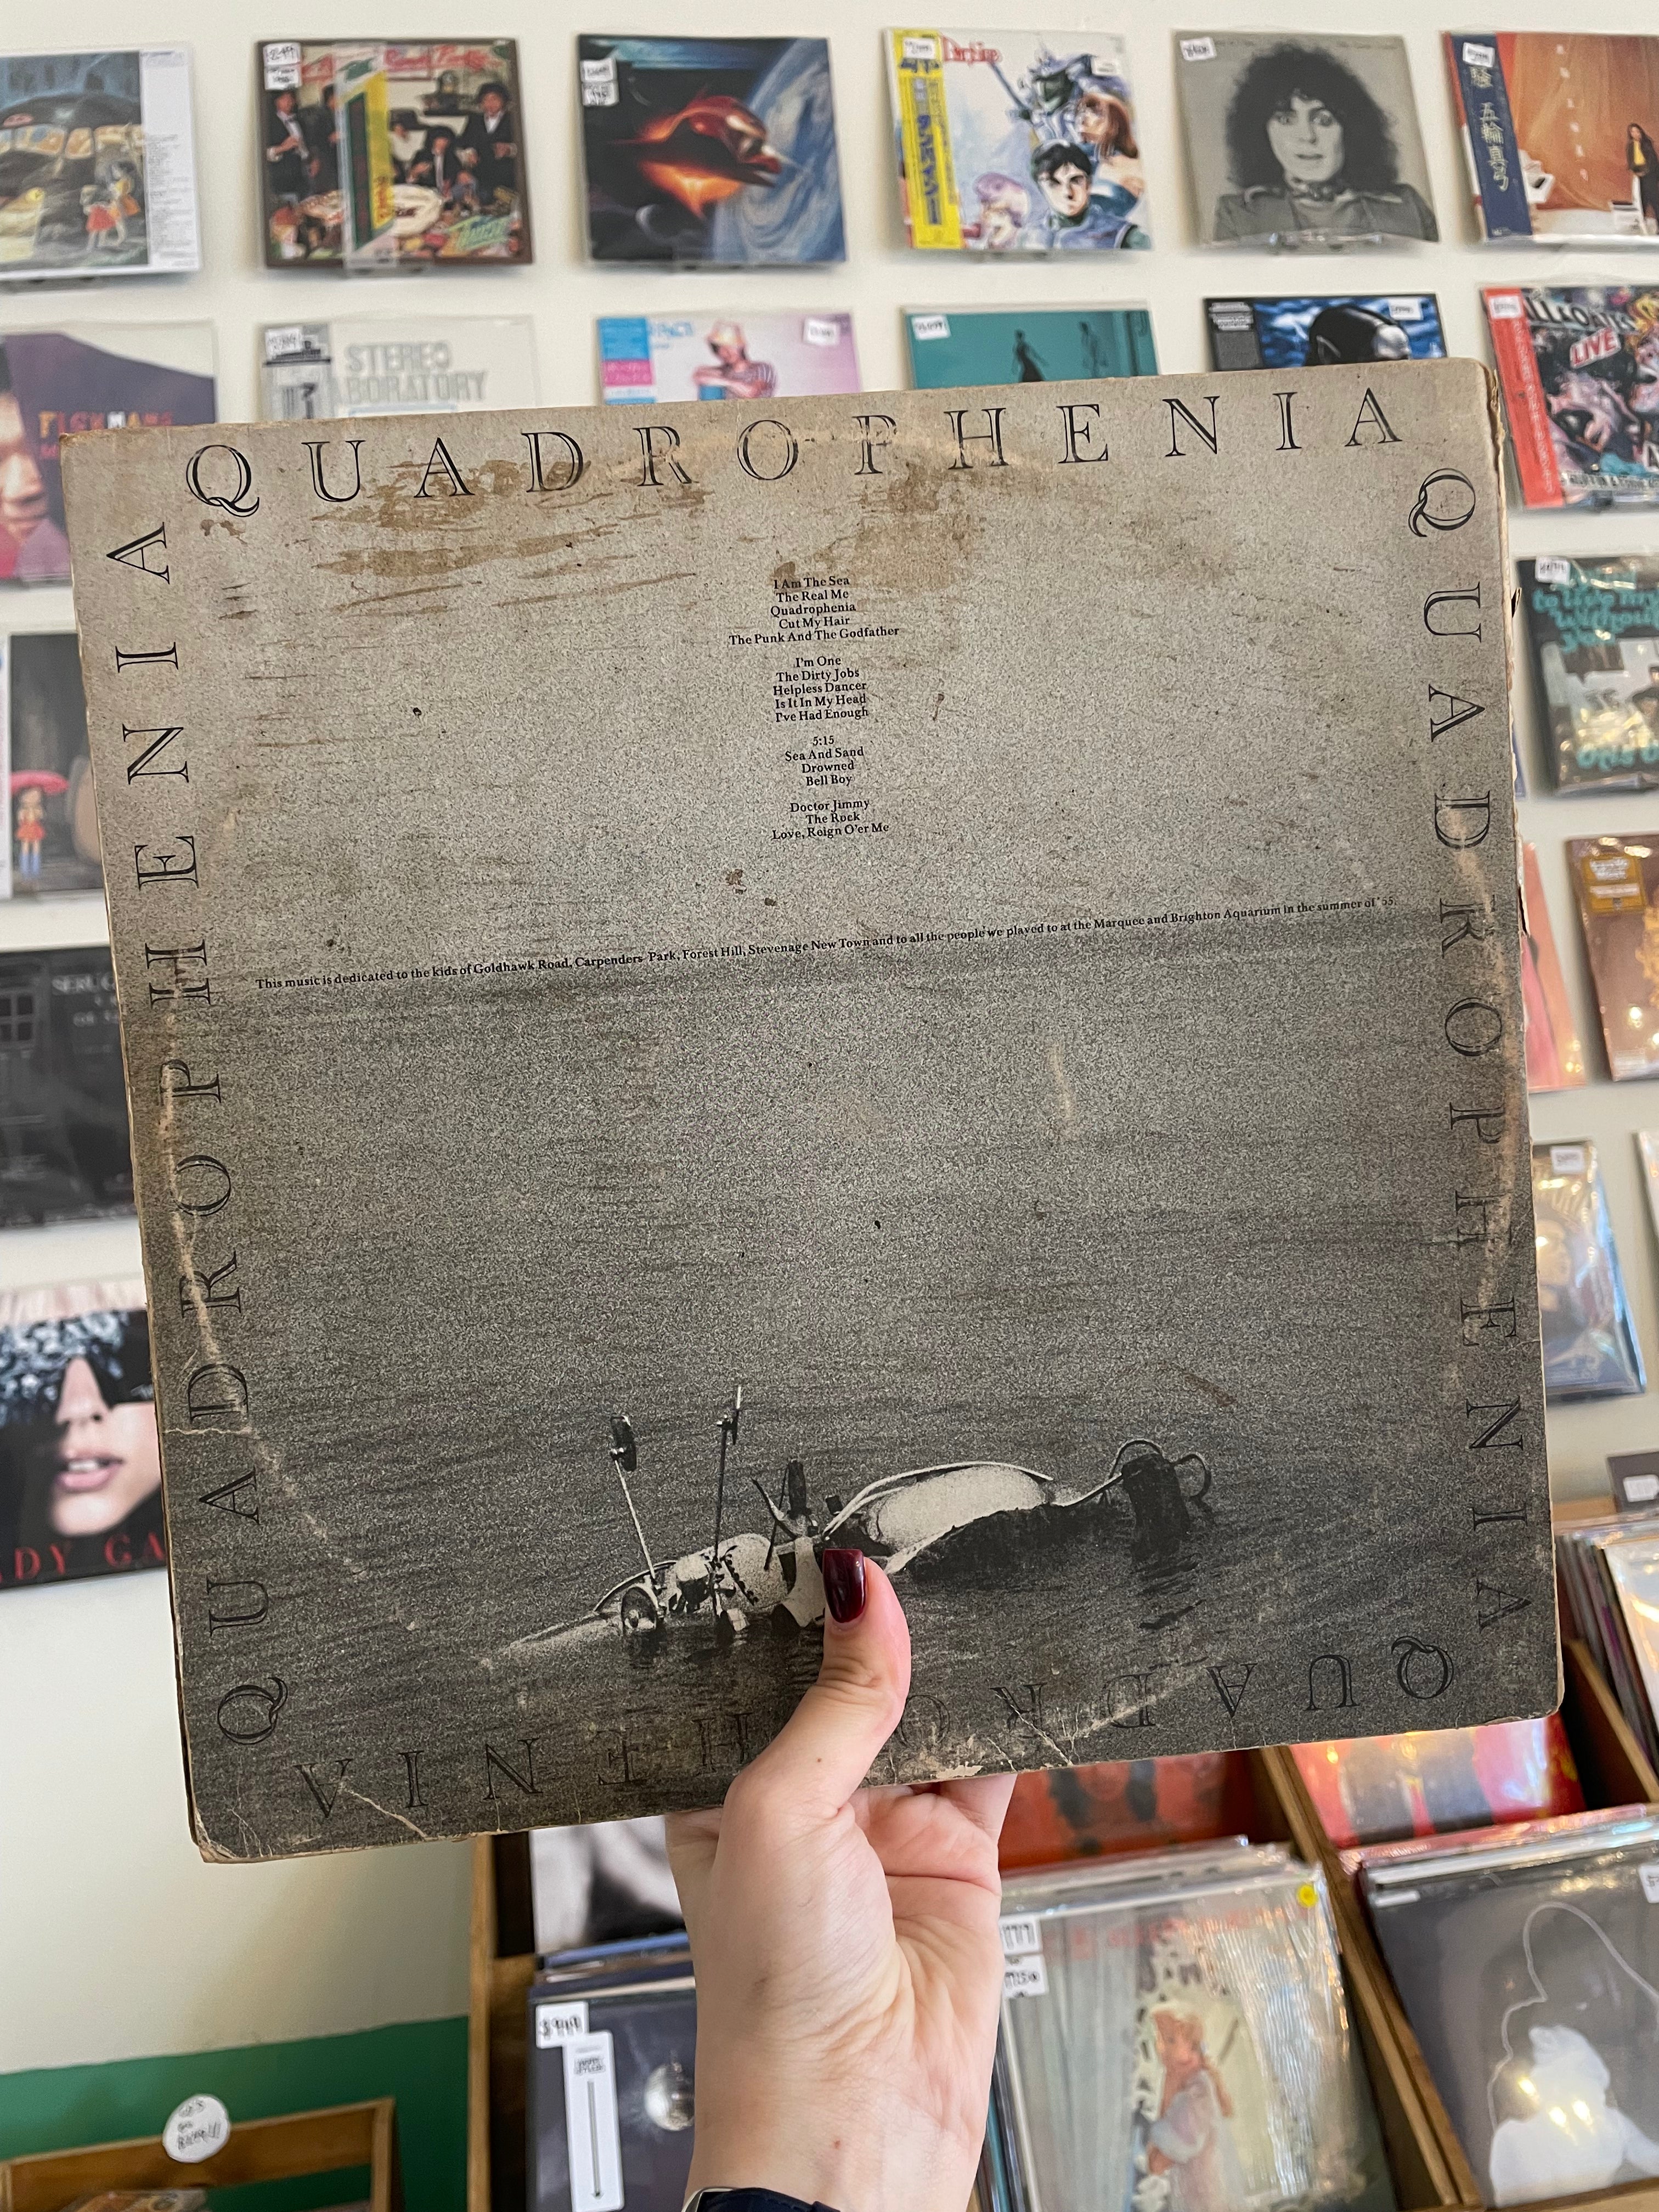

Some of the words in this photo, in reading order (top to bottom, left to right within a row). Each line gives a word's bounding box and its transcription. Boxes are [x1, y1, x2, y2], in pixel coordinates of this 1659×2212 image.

[185, 387, 1403, 518] QUADROPHENIA
[773, 579, 778, 589] I
[782, 579, 802, 589] Am
[803, 577, 827, 588] The
[828, 575, 850, 586] Sea
[775, 592, 799, 602] The
[802, 590, 828, 601] Real
[831, 589, 849, 600] Me
[770, 603, 856, 618] Quadrophenia
[778, 618, 800, 629] Cut
[802, 617, 821, 629] My
[823, 616, 850, 627] Hair
[729, 634, 752, 646] The
[754, 633, 785, 644] Punk
[787, 630, 812, 642] And
[814, 630, 837, 640] The
[839, 627, 900, 639] Godfather
[795, 657, 814, 668] I'm
[816, 656, 842, 667] One
[776, 672, 799, 682] The
[801, 669, 831, 682] Dirty
[833, 668, 860, 682] Jobs
[772, 683, 822, 698] Helpless
[825, 682, 867, 693] Dancer
[775, 699, 786, 709] Is
[788, 698, 798, 708] It
[799, 697, 812, 707] In
[815, 696, 833, 708] My
[835, 693, 867, 706] Head
[775, 712, 797, 723] I've
[798, 710, 822, 721] Had
[825, 707, 869, 720] Enough
[812, 735, 834, 746] 5:15
[785, 751, 806, 762] Sea
[808, 749, 832, 760] And
[834, 746, 864, 758] Sand
[801, 760, 855, 774] Drowned
[805, 775, 828, 787] Bell
[831, 774, 853, 787] Boy
[789, 802, 830, 813] Doctor
[830, 799, 870, 813] Jimmy
[805, 814, 828, 825] The
[830, 811, 861, 823] Rock
[771, 830, 805, 840] Love,
[807, 826, 842, 839] Reign
[844, 824, 869, 835] O'er
[871, 822, 889, 833] Me
[255, 978, 283, 989] This
[285, 975, 320, 988] music
[322, 974, 332, 985] is
[334, 969, 394, 984] dedicated
[396, 969, 409, 980] to
[410, 967, 430, 979] the
[432, 966, 458, 977] kids
[459, 964, 472, 975] of
[473, 960, 535, 975] Goldhawk
[537, 958, 573, 970] Road,
[574, 954, 644, 969] Carpenders
[647, 951, 681, 962] Park,
[682, 947, 719, 960] Forest
[720, 945, 746, 958] Hill,
[748, 941, 809, 955] Stevenage
[811, 939, 837, 951] New
[839, 938, 870, 949] Town
[872, 935, 894, 947] and
[895, 934, 908, 944] to
[909, 932, 924, 943] all
[926, 931, 945, 942] the
[946, 927, 985, 942] people
[986, 928, 1003, 938] we
[1006, 923, 1045, 938] played
[1046, 922, 1058, 933] to
[1059, 921, 1072, 931] at
[1073, 919, 1092, 930] the
[1093, 916, 1145, 930] Marquee
[1147, 913, 1169, 926] and
[1170, 910, 1221, 926] Brighton
[1223, 906, 1282, 921] Aquarium
[1283, 904, 1294, 914] in
[1296, 902, 1315, 913] the
[1316, 900, 1362, 912] summer
[1364, 898, 1376, 908] of
[1408, 468, 1532, 1634] QUADROPHENIA
[106, 521, 287, 1746] QUADROPHENIA
[292, 1635, 1455, 1819] QUADROHENIA
